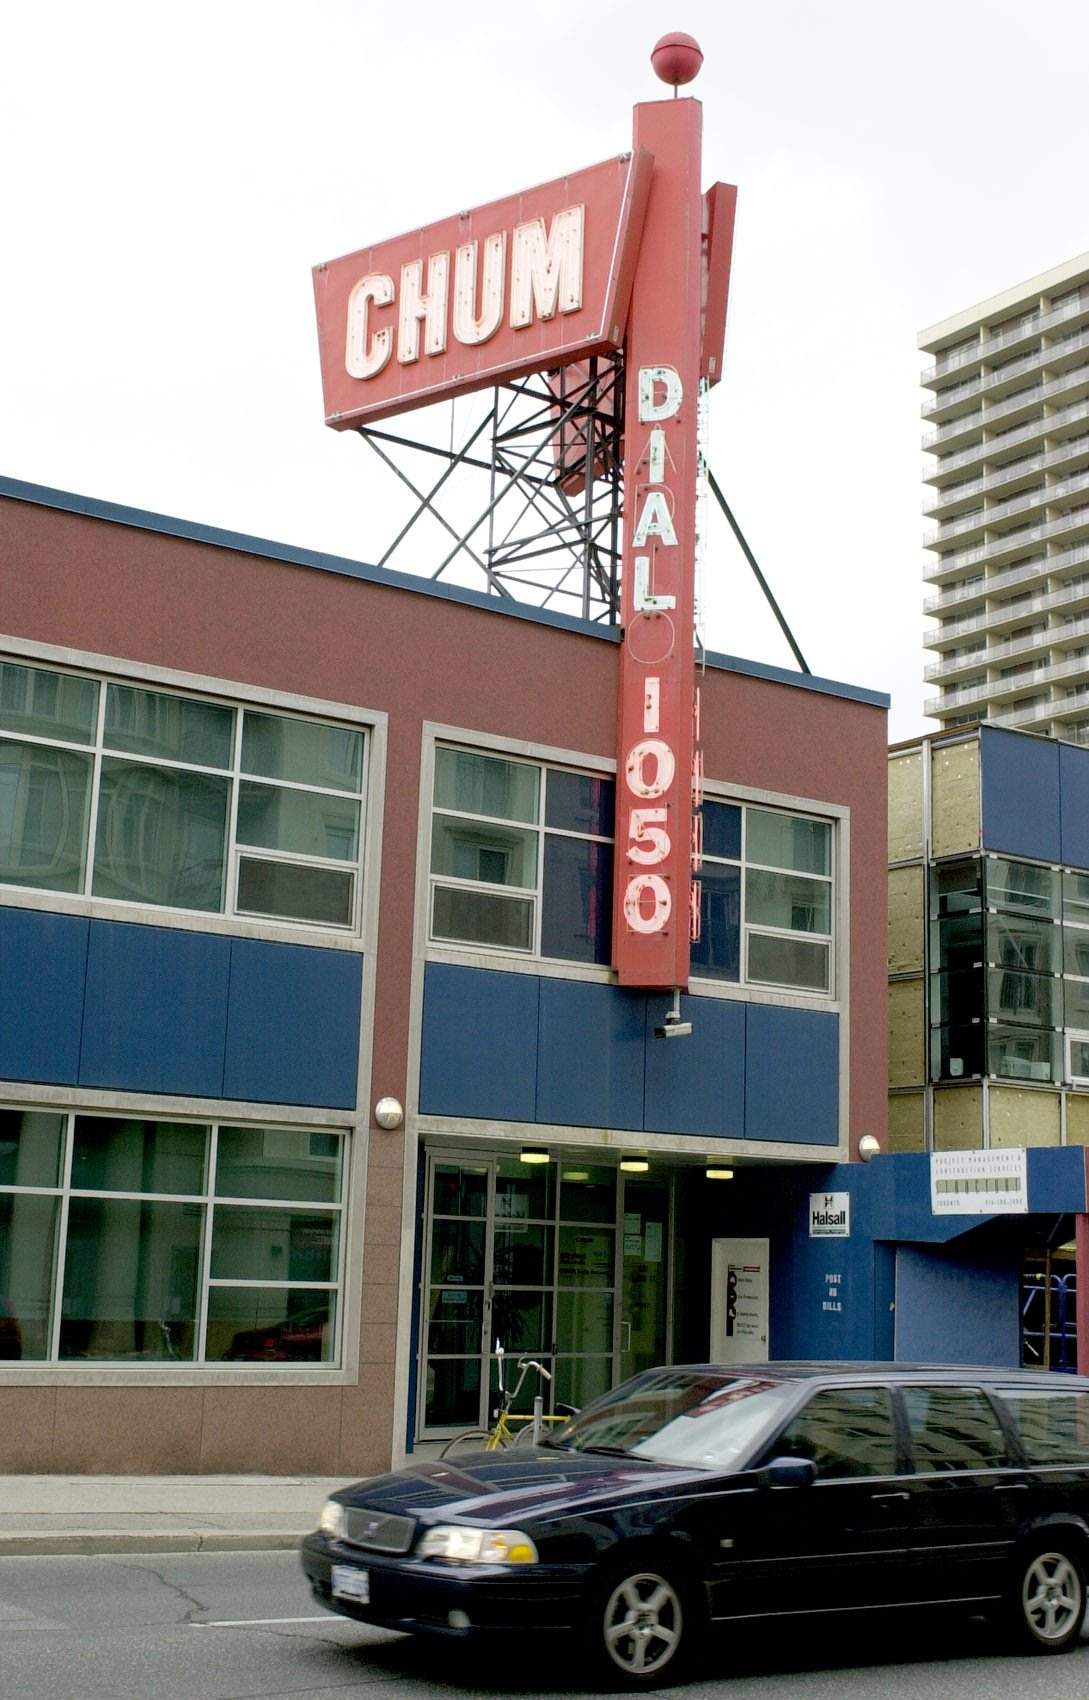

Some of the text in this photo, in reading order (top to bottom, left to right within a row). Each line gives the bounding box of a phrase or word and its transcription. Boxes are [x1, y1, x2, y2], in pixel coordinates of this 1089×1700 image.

[345, 202, 585, 381] CHUM
[632, 367, 683, 611] DIAL
[623, 677, 676, 934] 1050
[812, 1210, 846, 1225] Halsall
[822, 1301, 842, 1312] BILLS
[824, 1273, 842, 1284] POST
